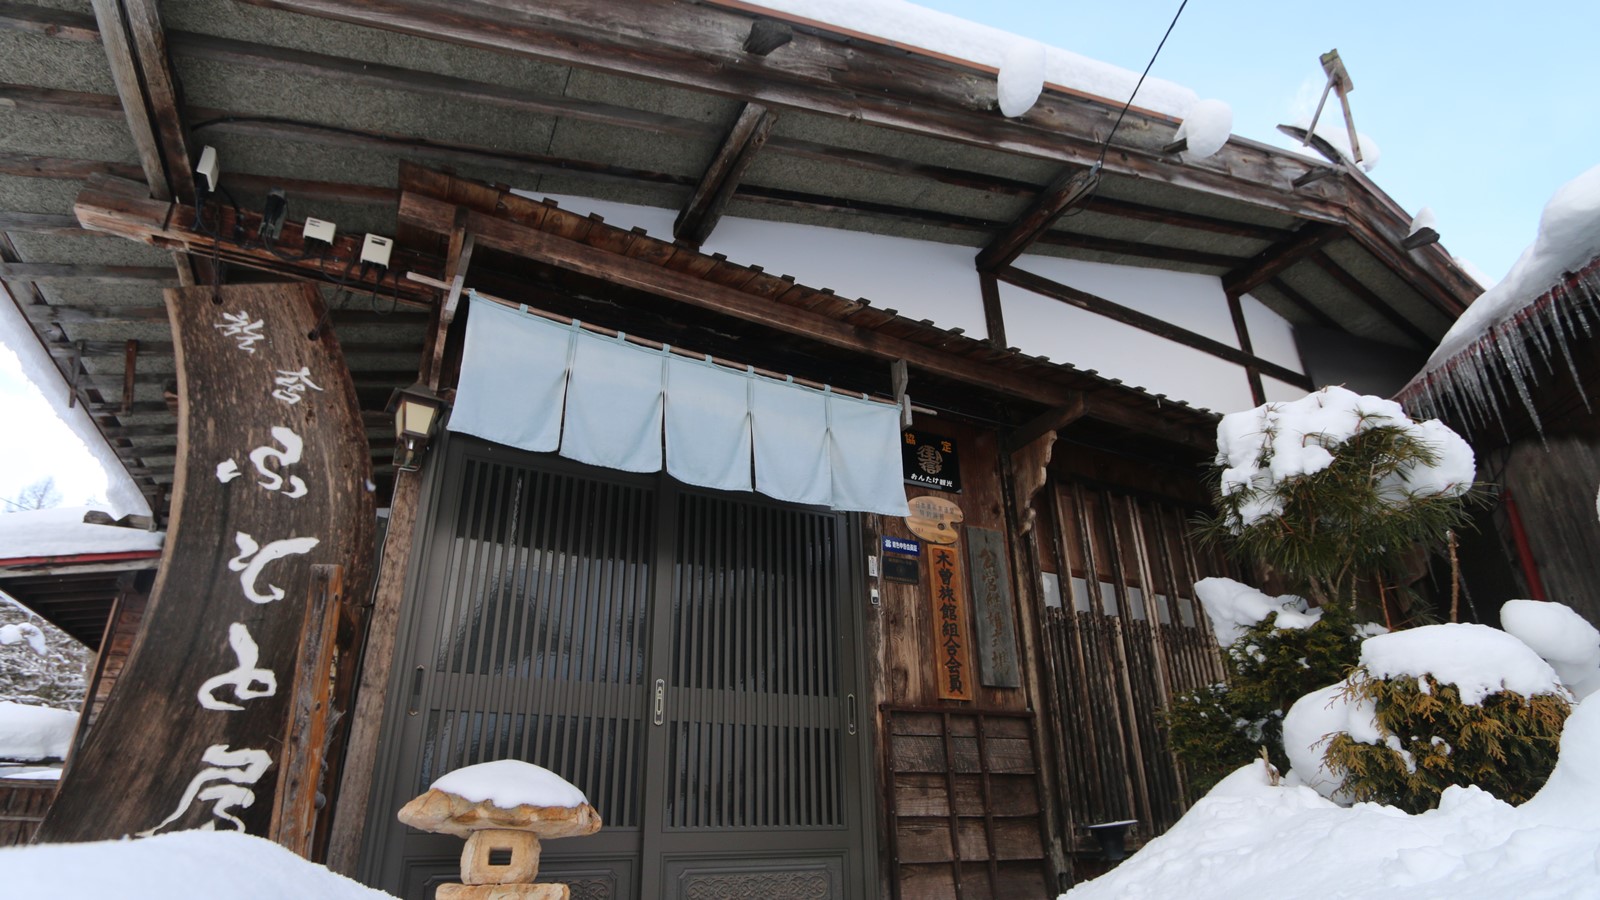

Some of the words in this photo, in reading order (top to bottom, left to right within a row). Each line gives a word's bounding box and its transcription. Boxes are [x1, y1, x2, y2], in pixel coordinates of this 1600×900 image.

[910, 473, 953, 488] おんたけ観光
